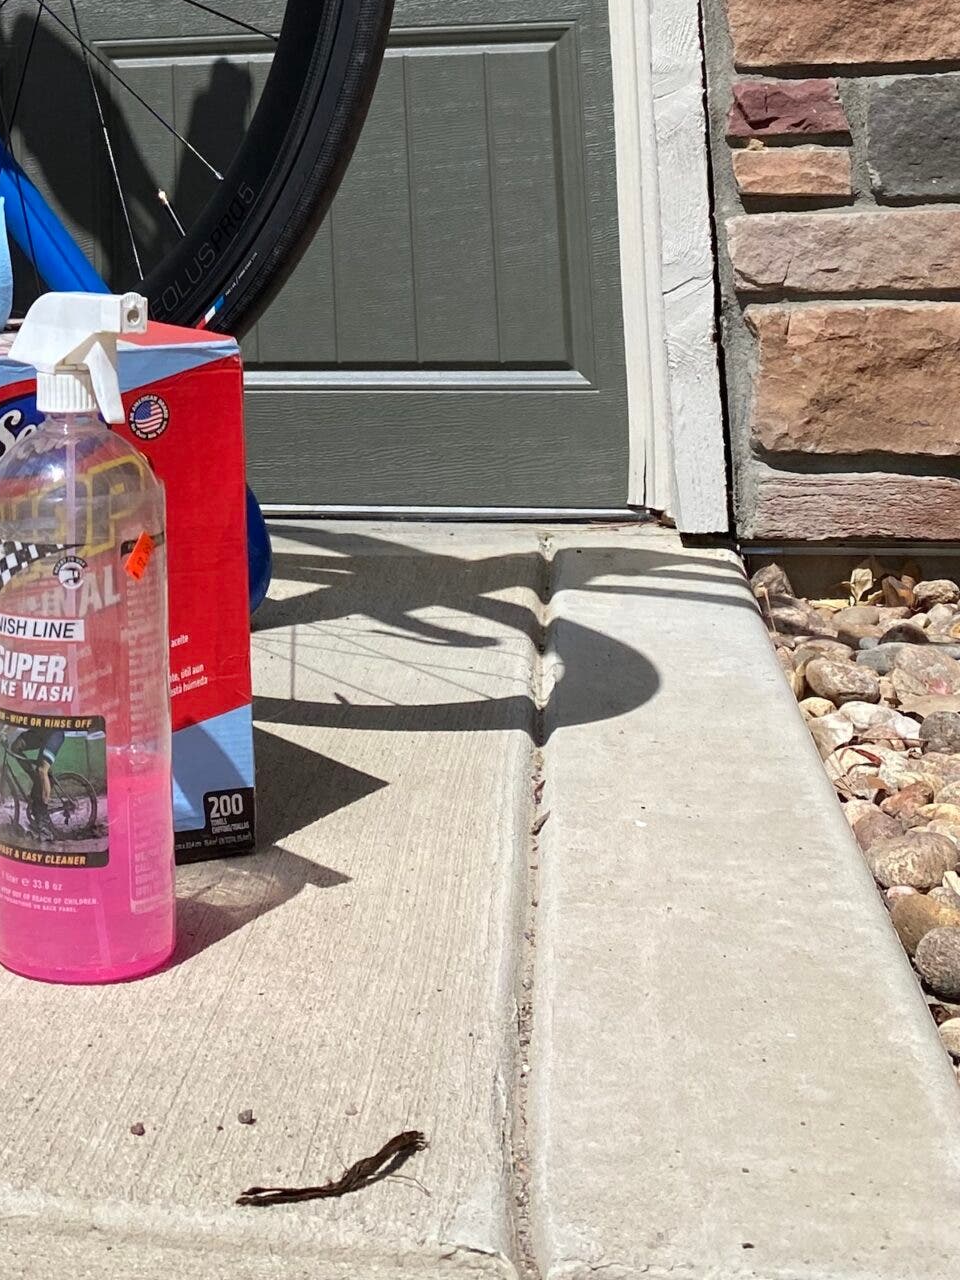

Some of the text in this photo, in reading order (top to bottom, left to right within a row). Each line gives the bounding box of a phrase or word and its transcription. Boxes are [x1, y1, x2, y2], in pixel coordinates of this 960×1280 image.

[150, 242, 216, 322] EOLUS
[33, 621, 76, 639] LINE
[22, 682, 74, 702] WASH
[44, 717, 72, 729] RINSE
[75, 719, 93, 729] OFF
[208, 793, 244, 819] 200
[21, 851, 42, 862] EASY
[44, 853, 87, 866] CLEANER
[32, 879, 50, 890] 33.8
[52, 883, 63, 891] oz
